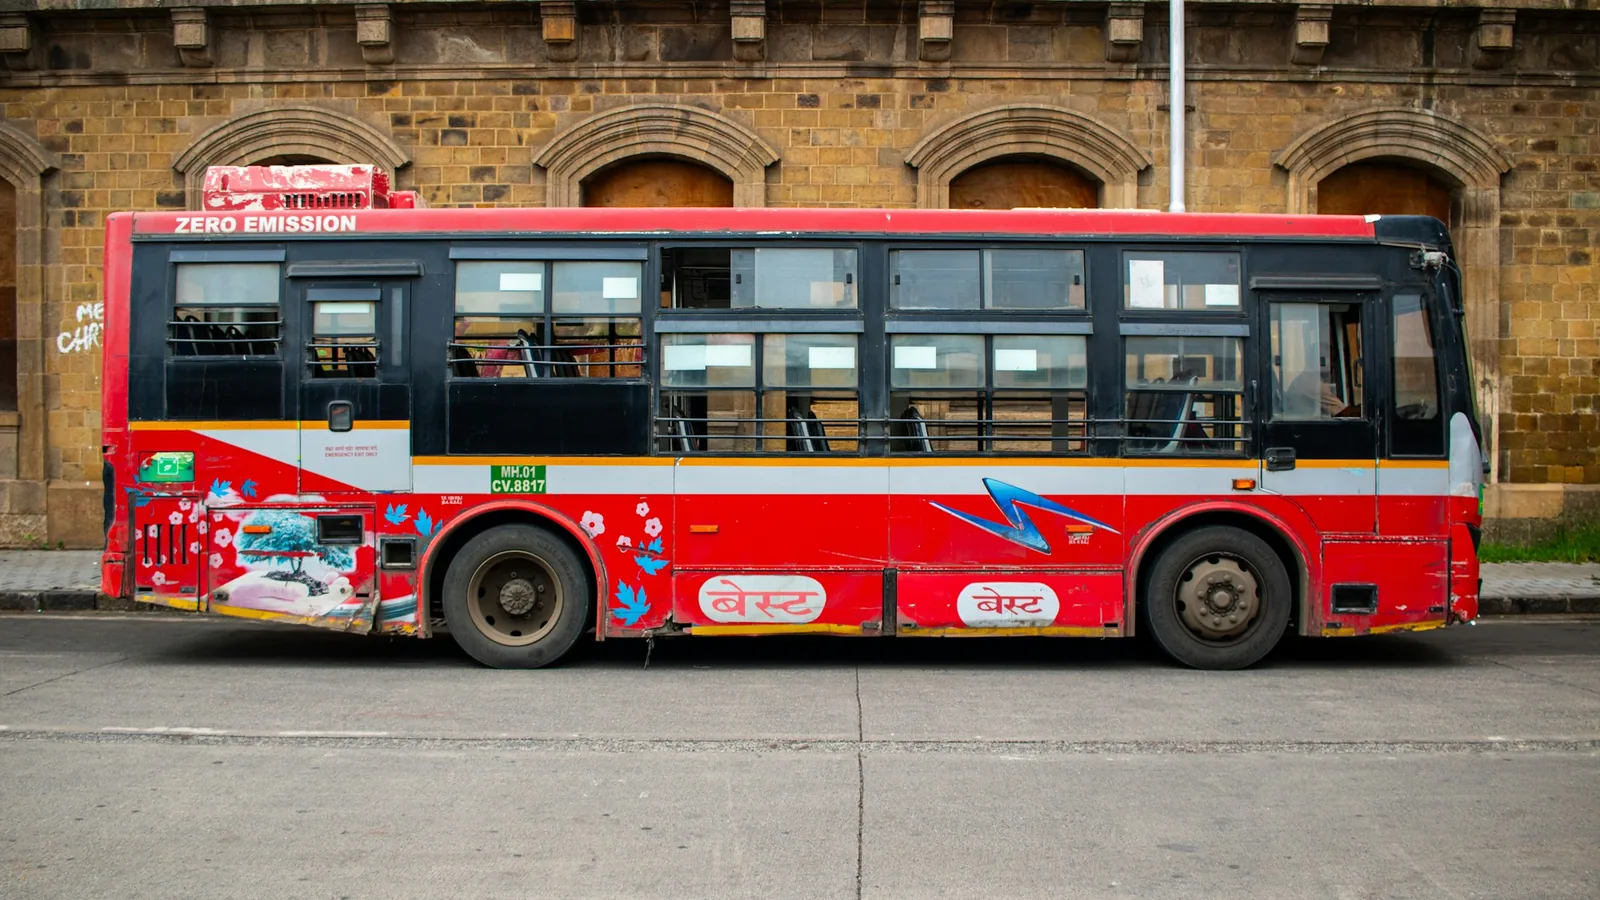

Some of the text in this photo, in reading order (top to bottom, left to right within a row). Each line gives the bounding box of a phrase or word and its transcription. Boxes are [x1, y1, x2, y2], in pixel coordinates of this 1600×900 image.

[175, 216, 356, 233] ZERO EMISSION
[57, 322, 104, 353] CHR
[501, 466, 535, 478] MH.01
[492, 480, 545, 492] CV.8817
[705, 580, 819, 618] बेस्ट
[972, 587, 1044, 613] बेस्ट
